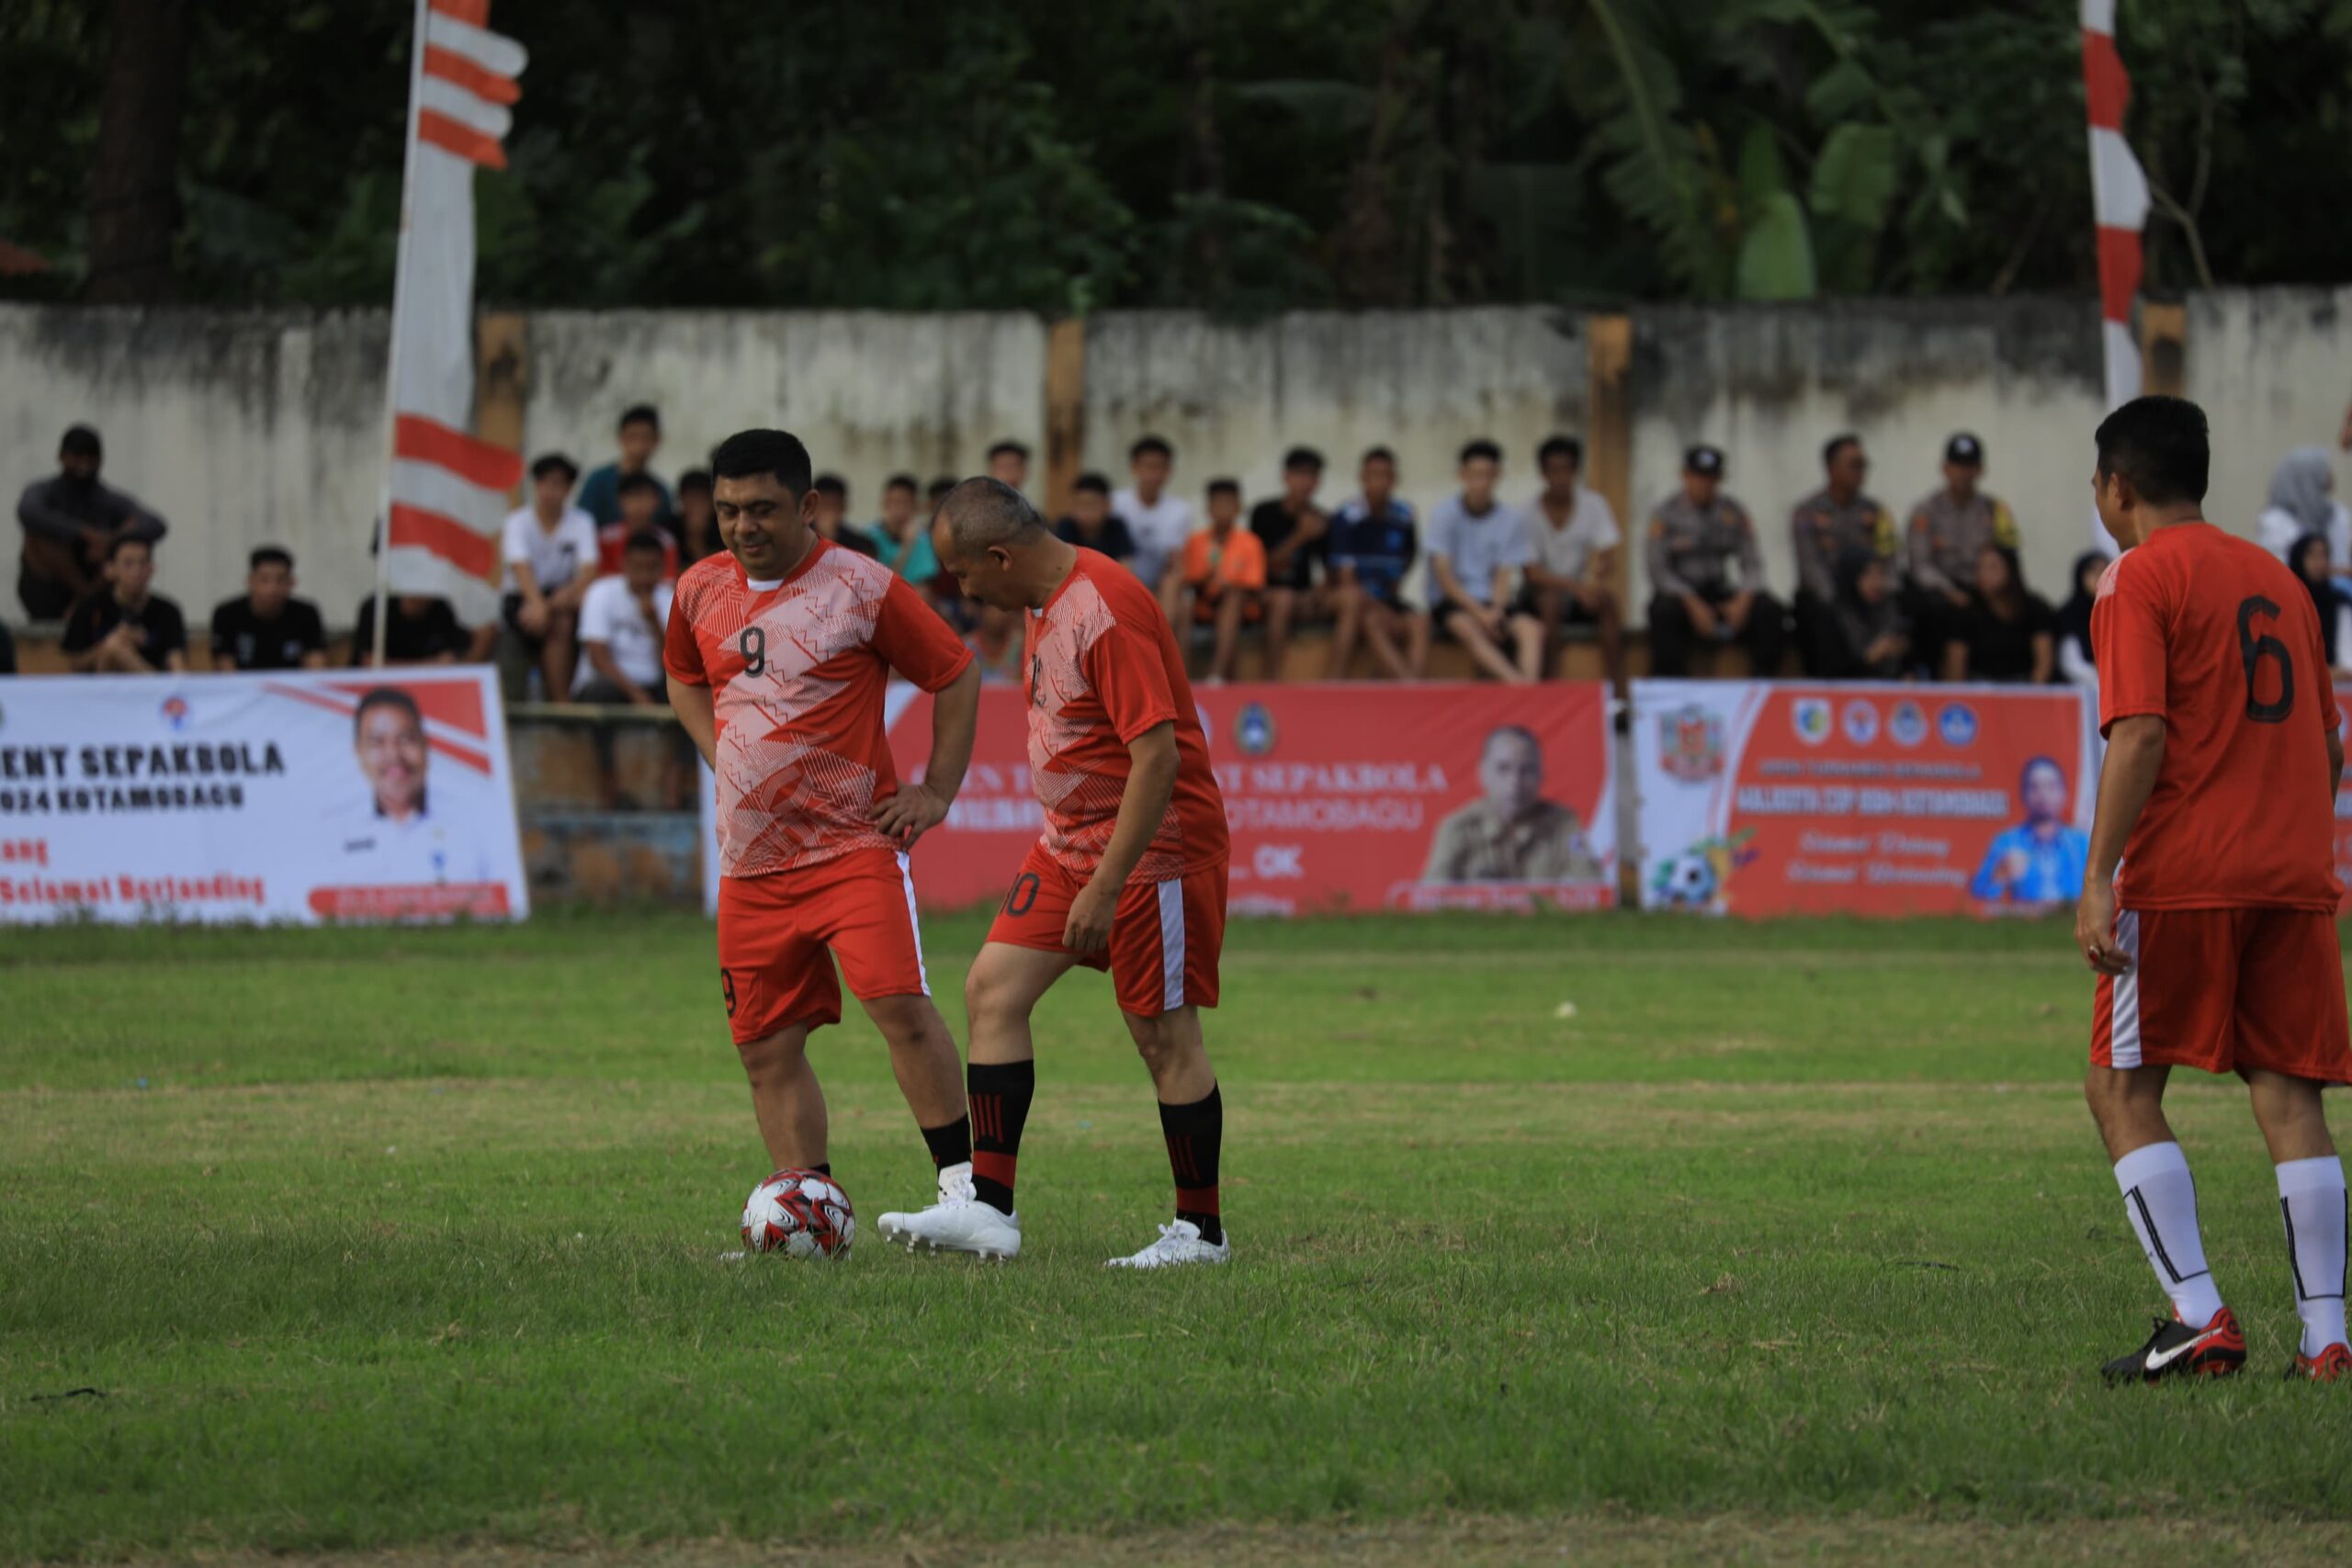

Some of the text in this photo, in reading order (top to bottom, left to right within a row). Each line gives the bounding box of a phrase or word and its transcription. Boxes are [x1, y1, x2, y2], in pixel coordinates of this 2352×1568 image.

[740, 626, 765, 678] 9
[2236, 594, 2294, 723] 6
[80, 742, 284, 778] SEPAKBOLA
[1226, 797, 1423, 830] OTAMOBAGU
